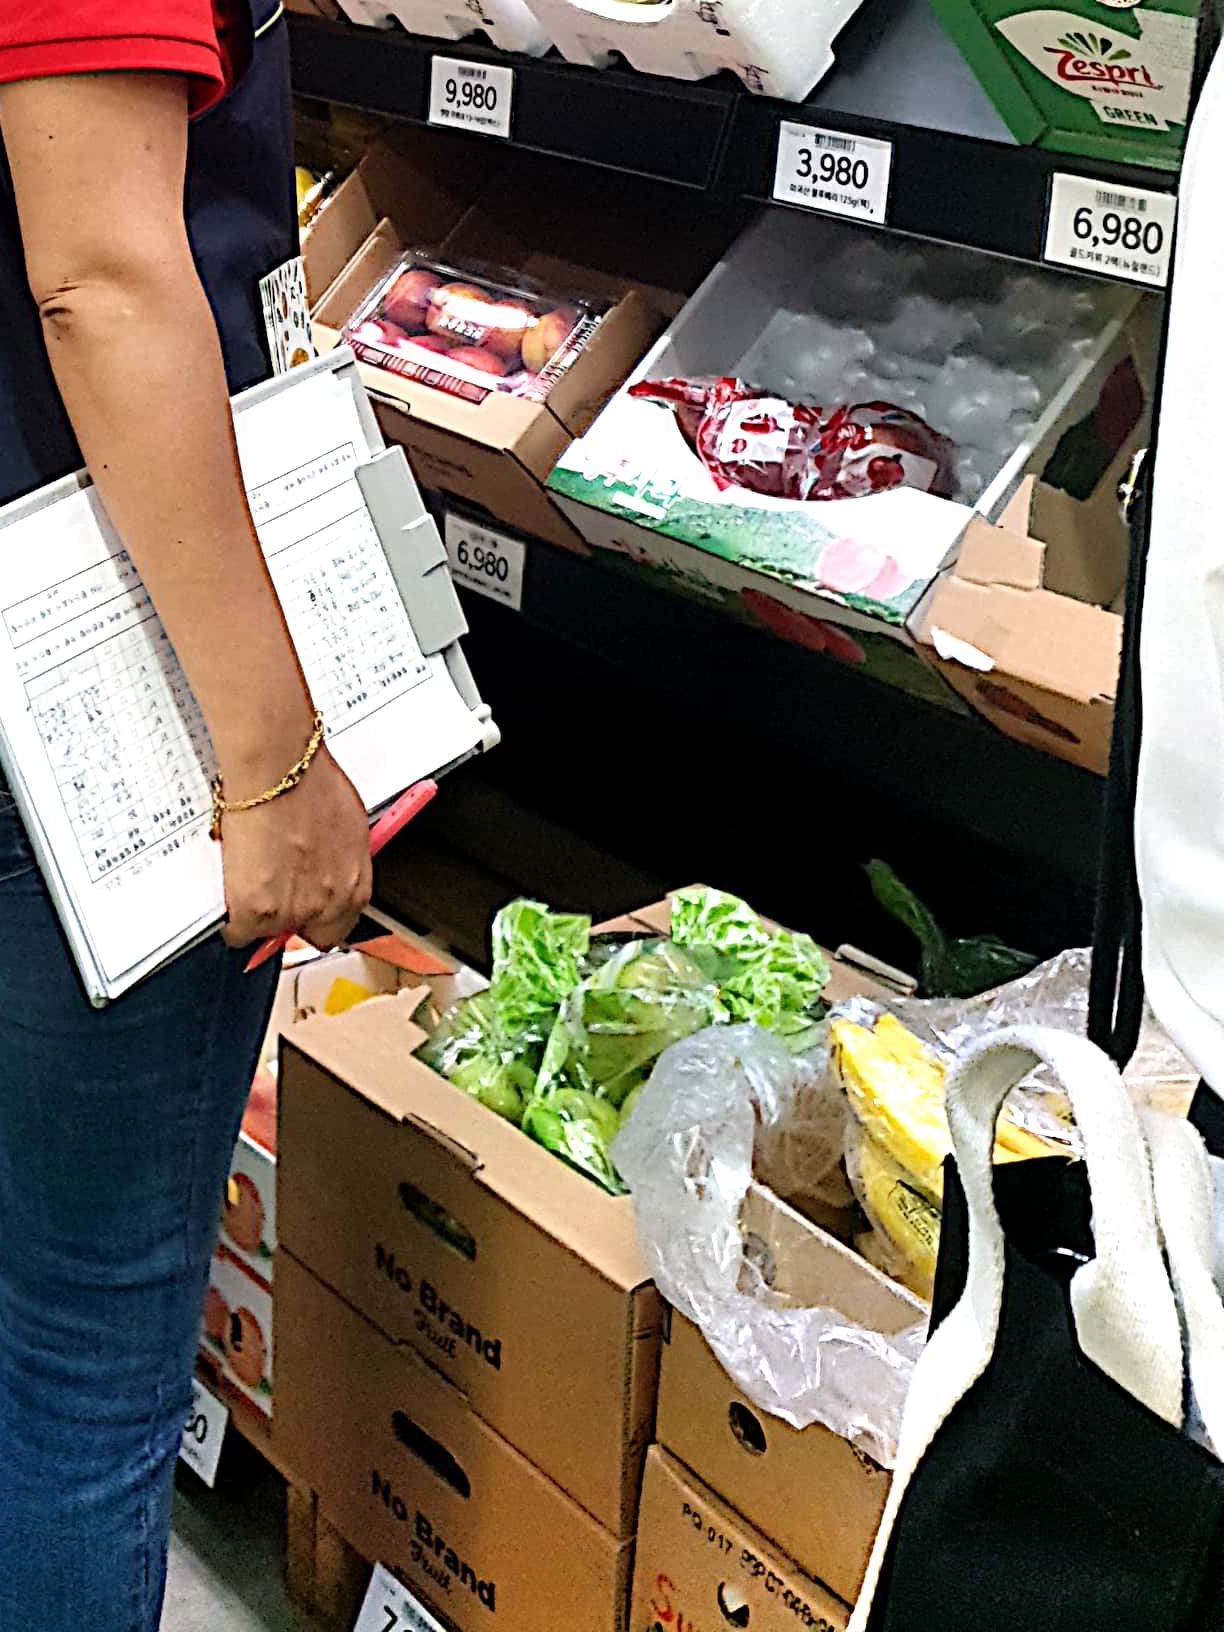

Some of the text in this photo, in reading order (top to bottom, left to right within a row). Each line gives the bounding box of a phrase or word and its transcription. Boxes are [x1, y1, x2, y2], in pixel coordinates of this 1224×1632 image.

[1043, 46, 1164, 91] Zespri
[445, 78, 498, 111] 9,980
[1103, 105, 1159, 127] GREEN
[796, 148, 870, 190] 3,980
[1073, 207, 1164, 255] 6,980
[457, 540, 509, 582] 6,980
[375, 1241, 502, 1372] No Brand
[371, 1469, 497, 1613] No Brand
